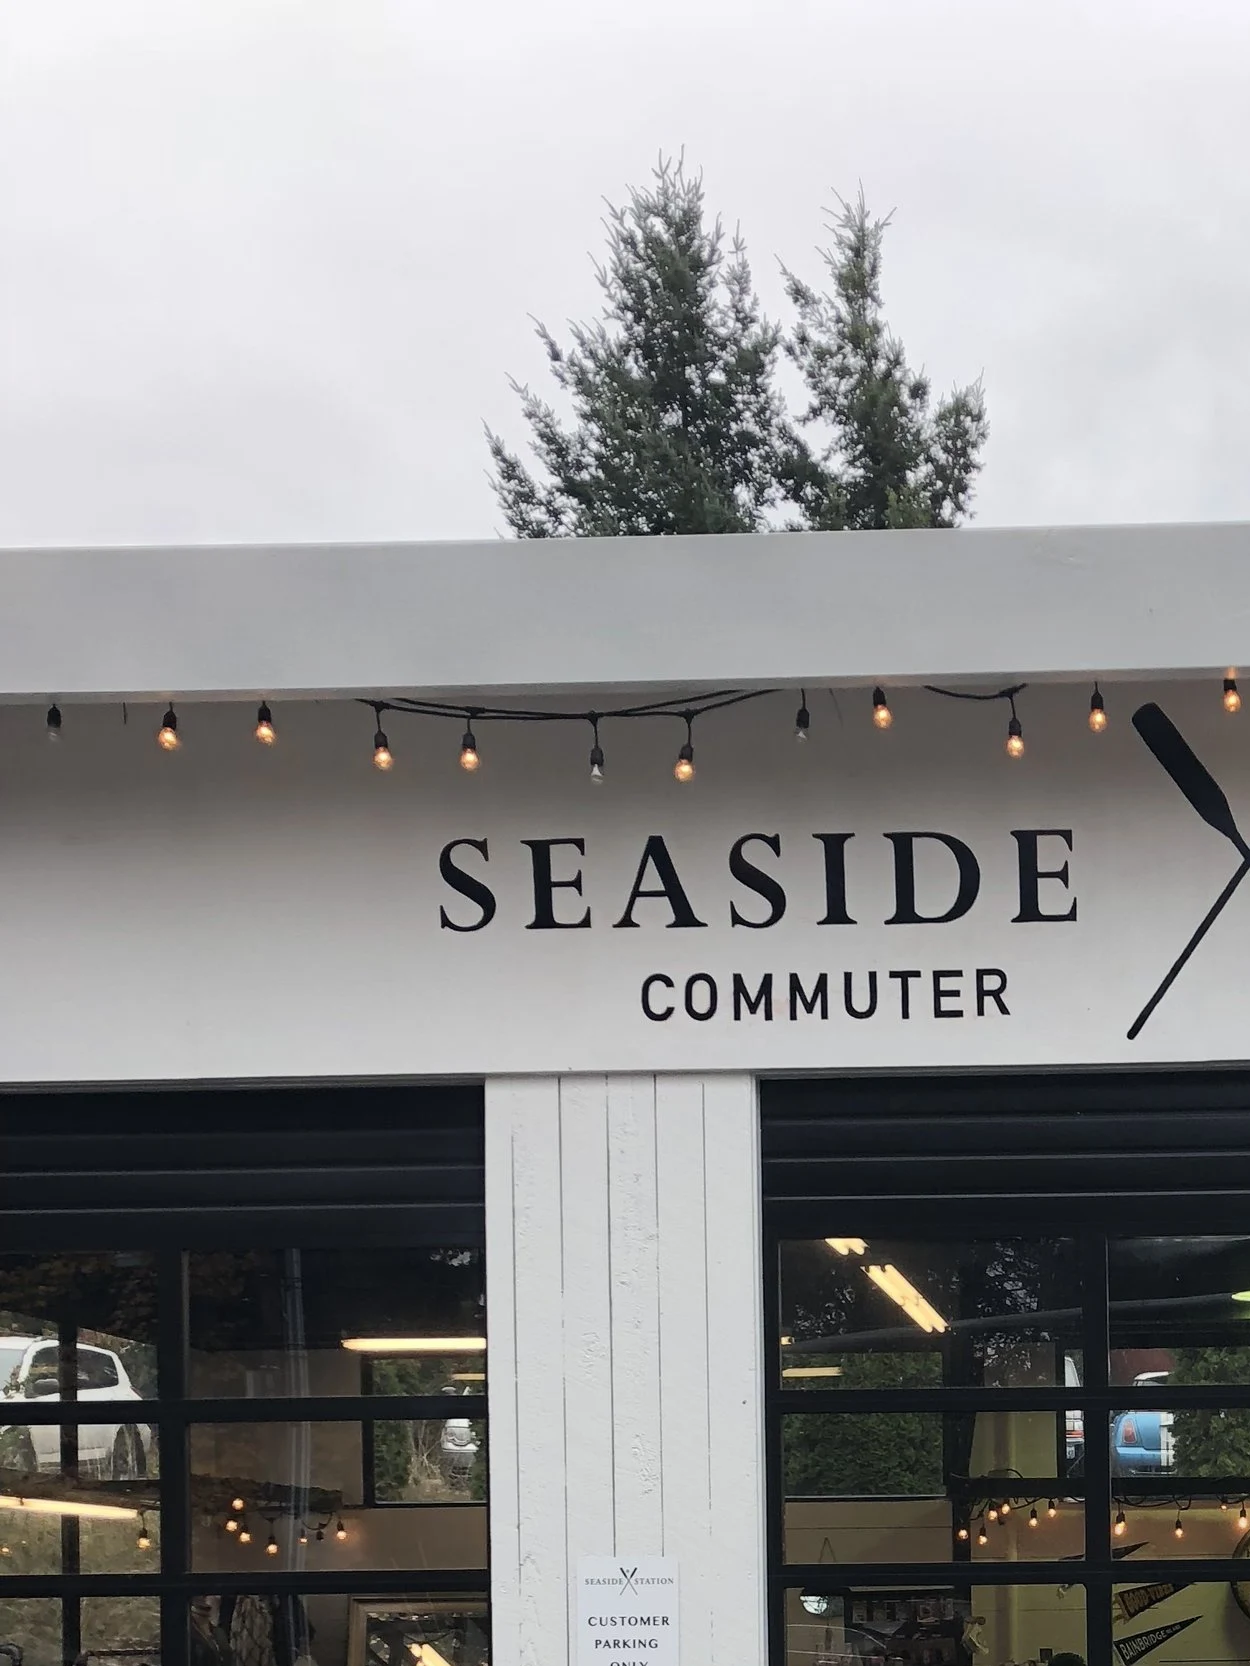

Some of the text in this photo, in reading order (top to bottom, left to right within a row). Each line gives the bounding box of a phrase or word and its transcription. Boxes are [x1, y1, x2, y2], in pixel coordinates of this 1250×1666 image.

[438, 829, 1078, 933] SEASIDE
[640, 967, 1011, 1022] COMMUTER
[584, 1577, 674, 1586] SEASIDE STATION
[587, 1615, 670, 1627] CUSTOMER
[594, 1638, 659, 1650] PARKING
[1119, 1630, 1168, 1661] BAINBRIDGE
